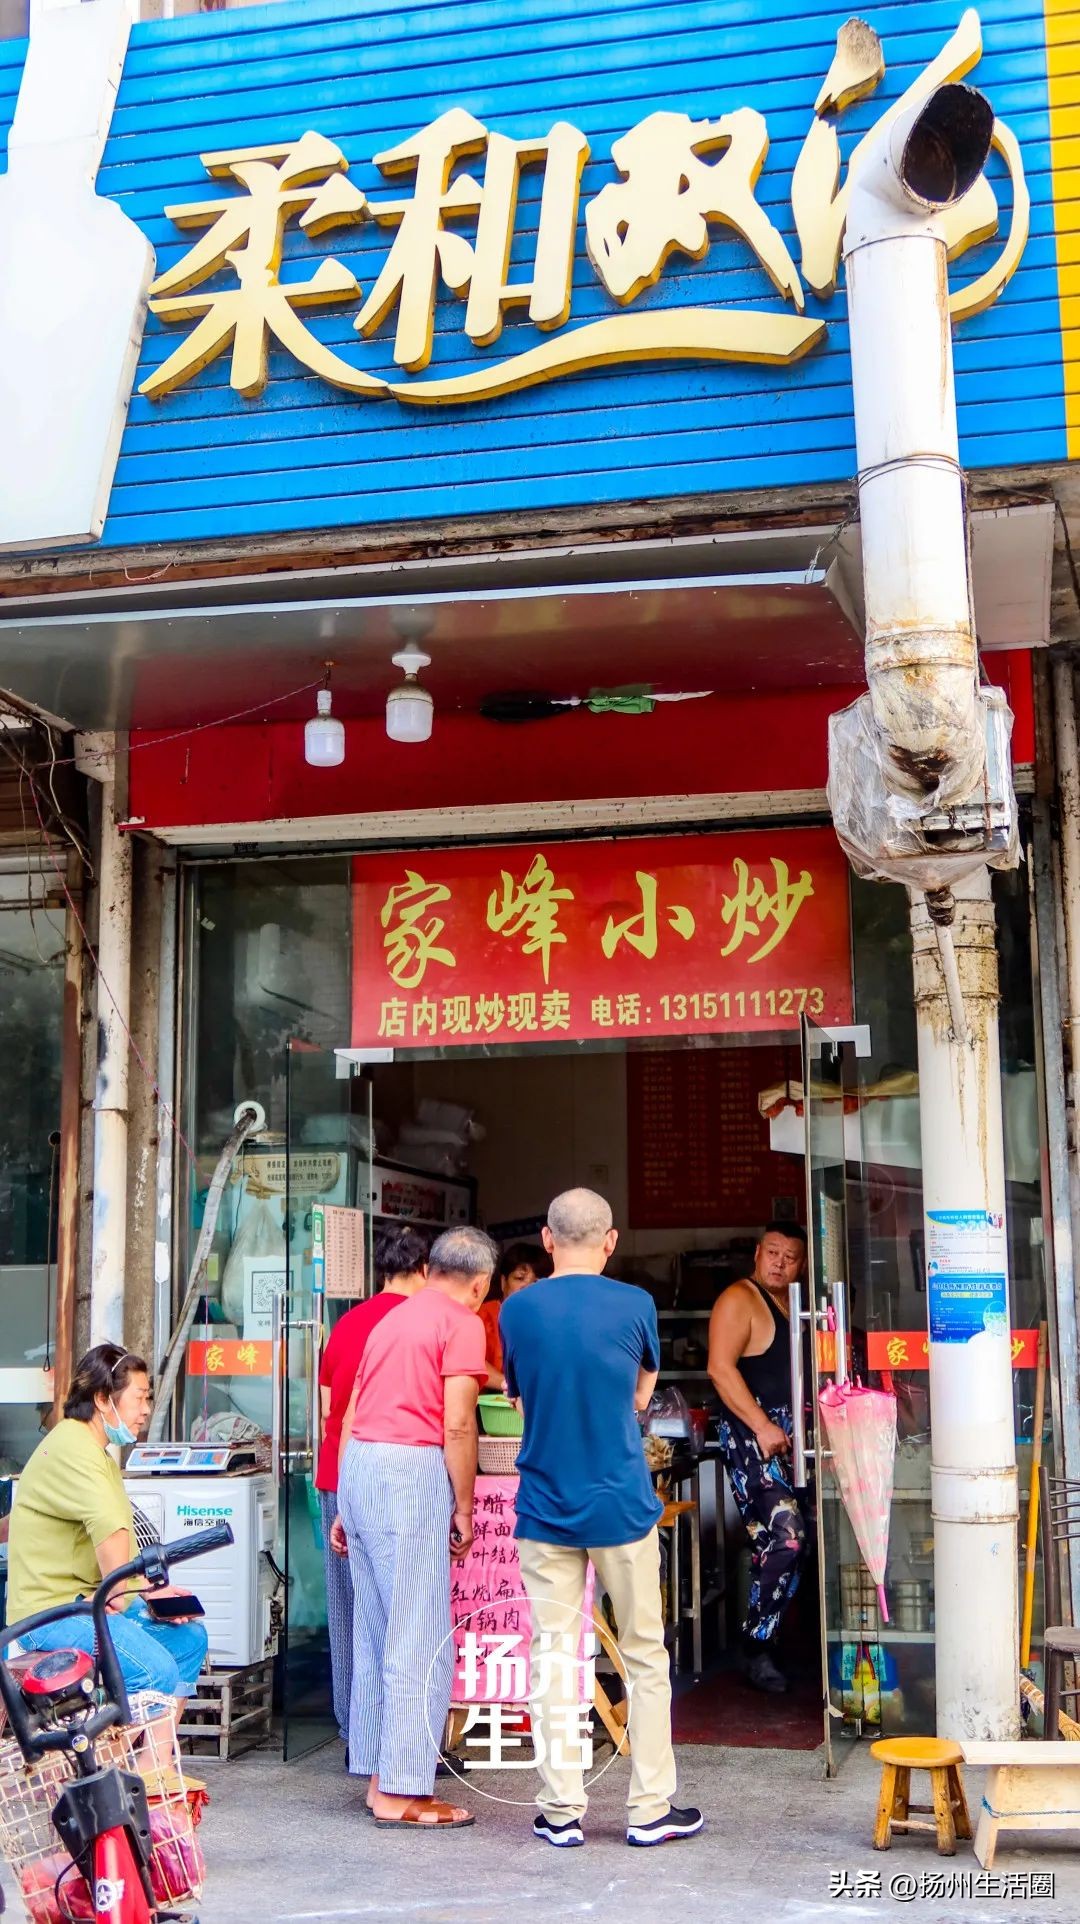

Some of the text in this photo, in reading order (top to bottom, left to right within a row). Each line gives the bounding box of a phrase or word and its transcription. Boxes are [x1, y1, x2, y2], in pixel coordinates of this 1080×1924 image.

[380, 853, 814, 988] 家峰小炒
[378, 990, 571, 1037] 店内现炒现卖
[207, 1343, 272, 1372] 家峰
[177, 1505, 233, 1516] Hisense
[451, 1579, 526, 1603] 红烧扁
[455, 1607, 519, 1631] 回锅肉
